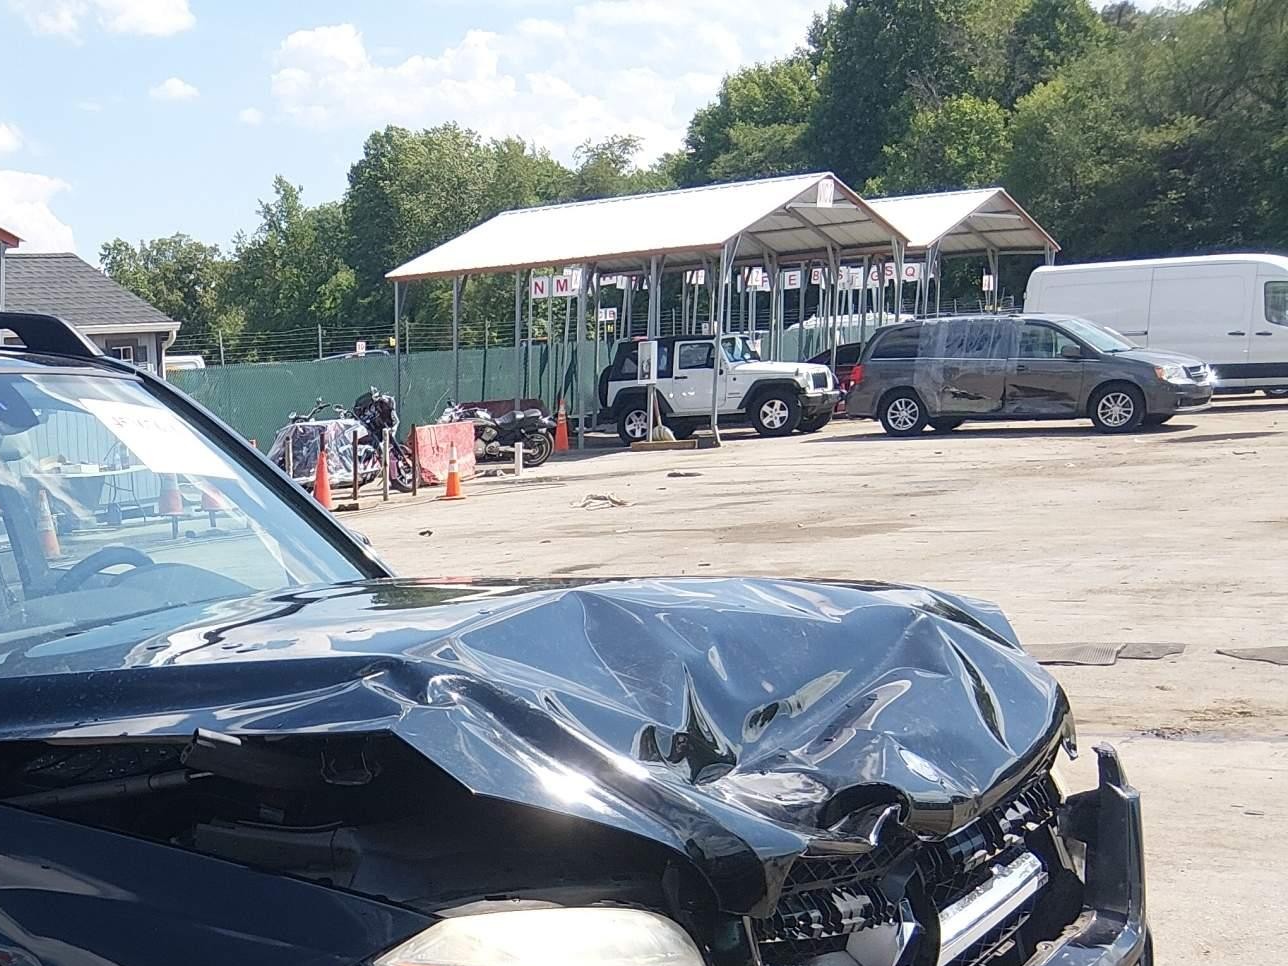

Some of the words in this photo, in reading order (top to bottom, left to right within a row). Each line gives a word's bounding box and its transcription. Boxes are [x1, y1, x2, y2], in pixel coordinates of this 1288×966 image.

[886, 265, 894, 277] S
[905, 266, 915, 277] Q
[556, 278, 568, 293] M
[788, 274, 797, 286] E
[534, 280, 544, 295] N
